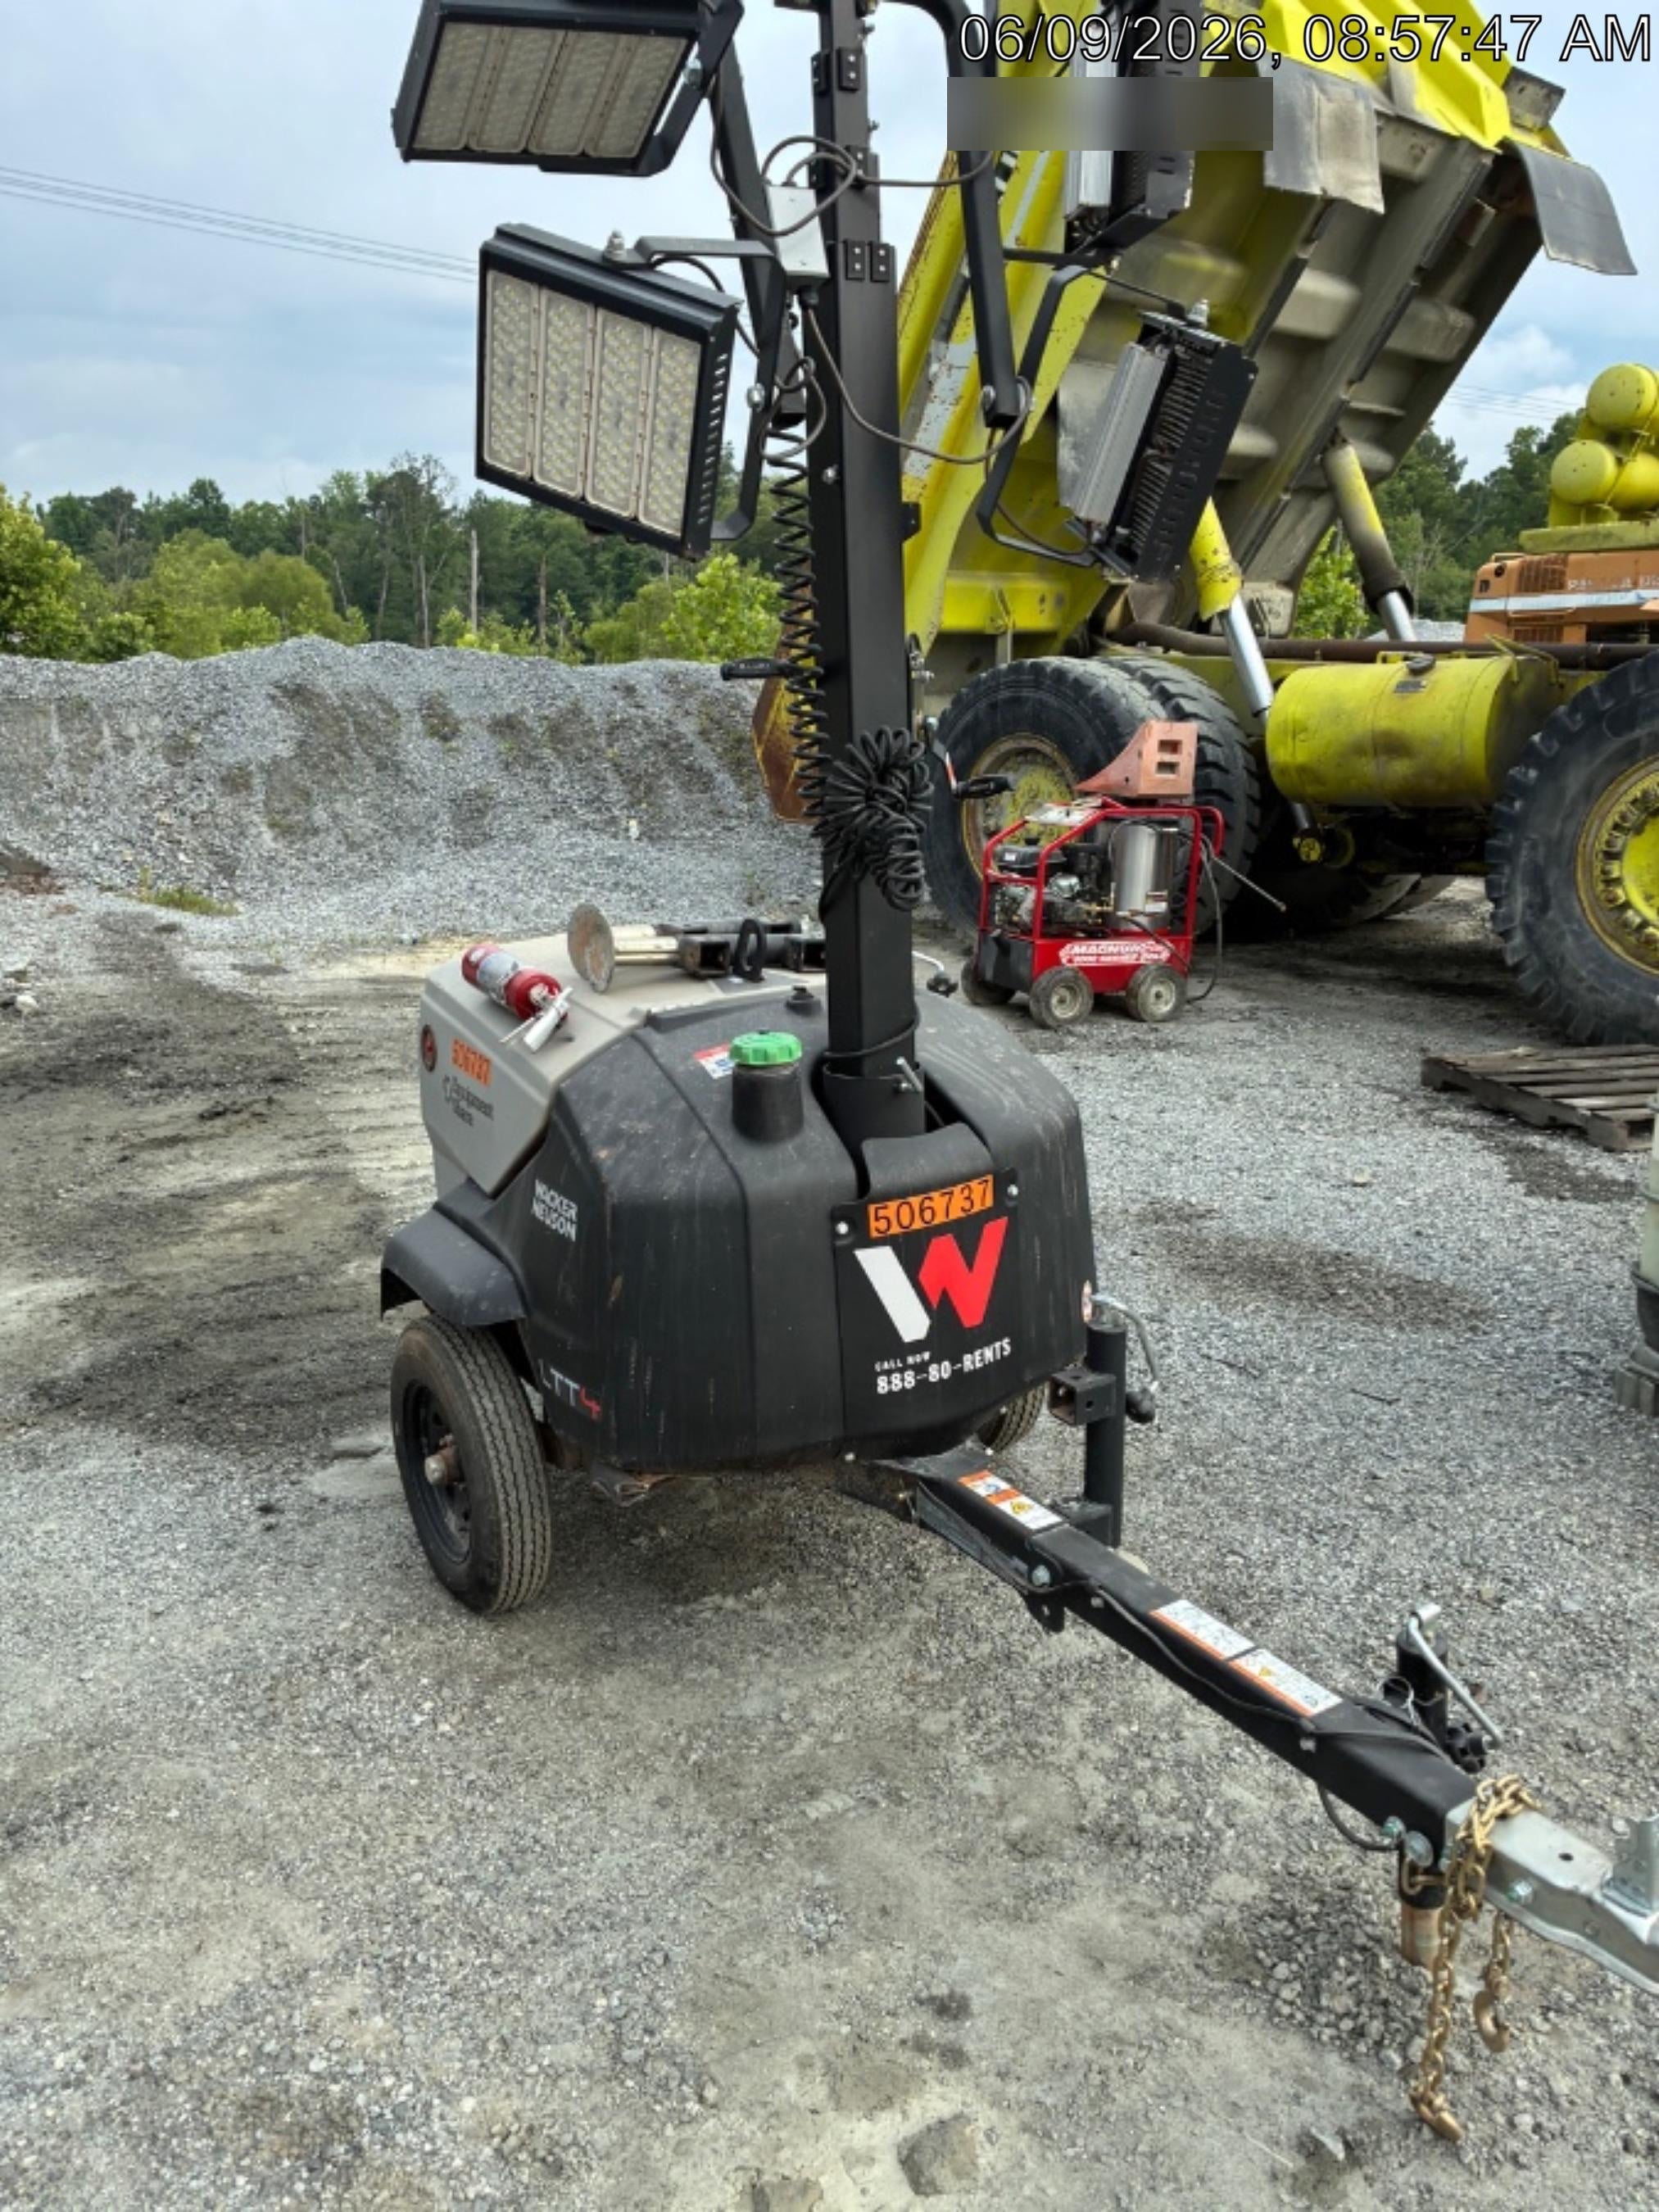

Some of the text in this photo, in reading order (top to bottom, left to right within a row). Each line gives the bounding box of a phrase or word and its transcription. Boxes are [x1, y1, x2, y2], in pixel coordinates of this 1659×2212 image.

[873, 1178, 990, 1235] 506737
[874, 1351, 931, 1372] CALL NOW
[876, 1336, 1012, 1395] 888-80-RENTS
